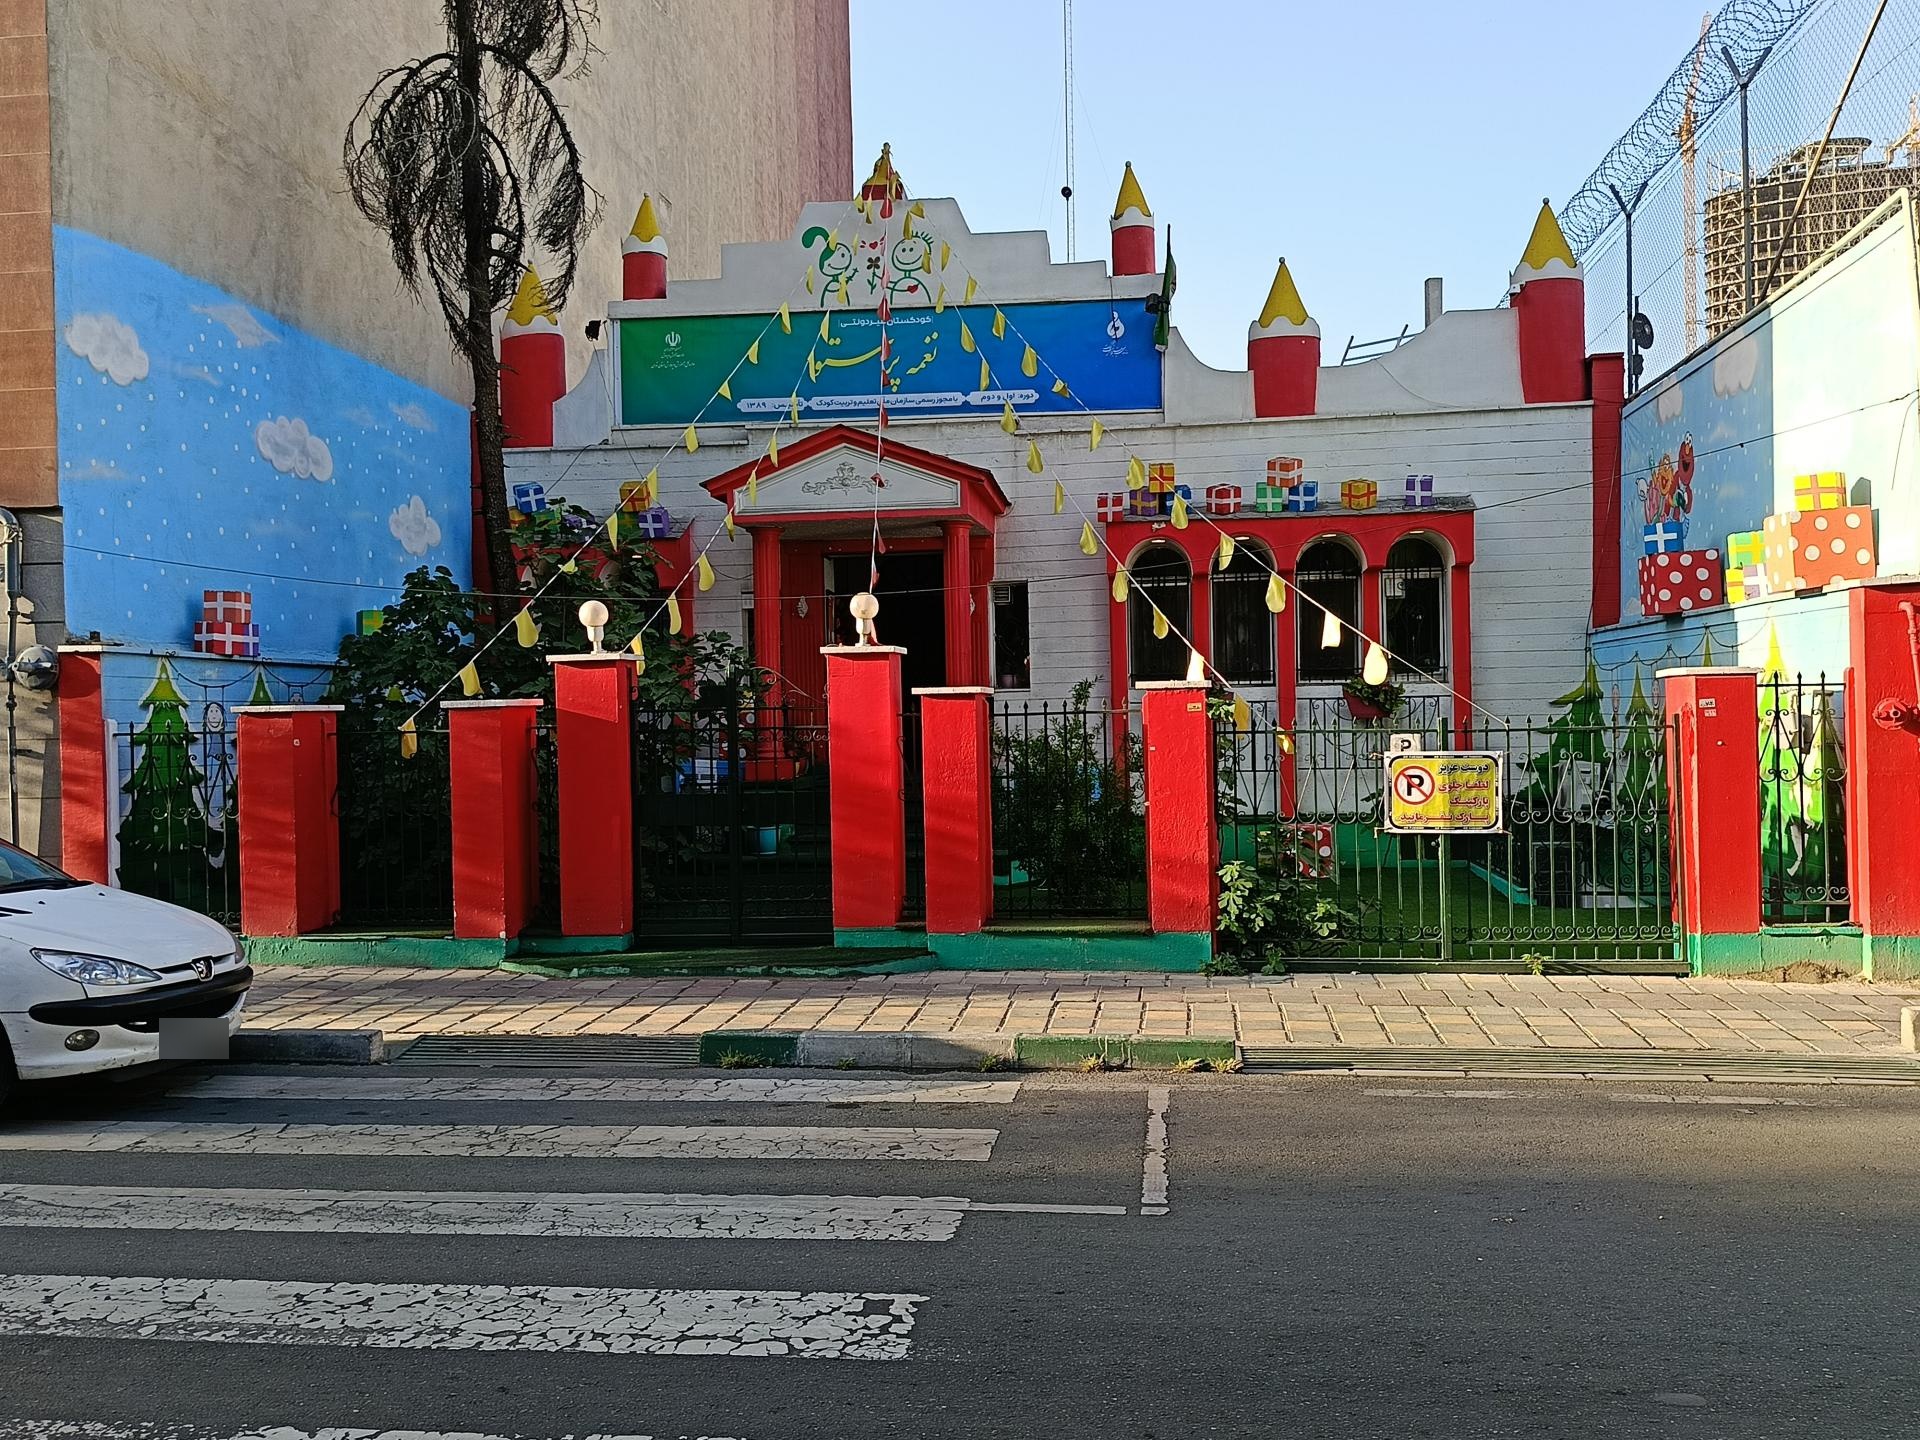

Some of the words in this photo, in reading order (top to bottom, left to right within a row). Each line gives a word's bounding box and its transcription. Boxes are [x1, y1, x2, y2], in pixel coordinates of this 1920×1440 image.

[887, 315, 931, 326] کودکستان
[906, 331, 939, 375] نغمه
[980, 394, 996, 403] دوم
[746, 401, 767, 409] ۱۳۸۹
[1438, 763, 1459, 775] عزیز
[1460, 763, 1489, 775] دوست
[1438, 780, 1464, 793] جلوی
[1465, 780, 1489, 790] لطفا
[1449, 795, 1490, 808] پارکینگ
[1455, 811, 1490, 824] پارک
